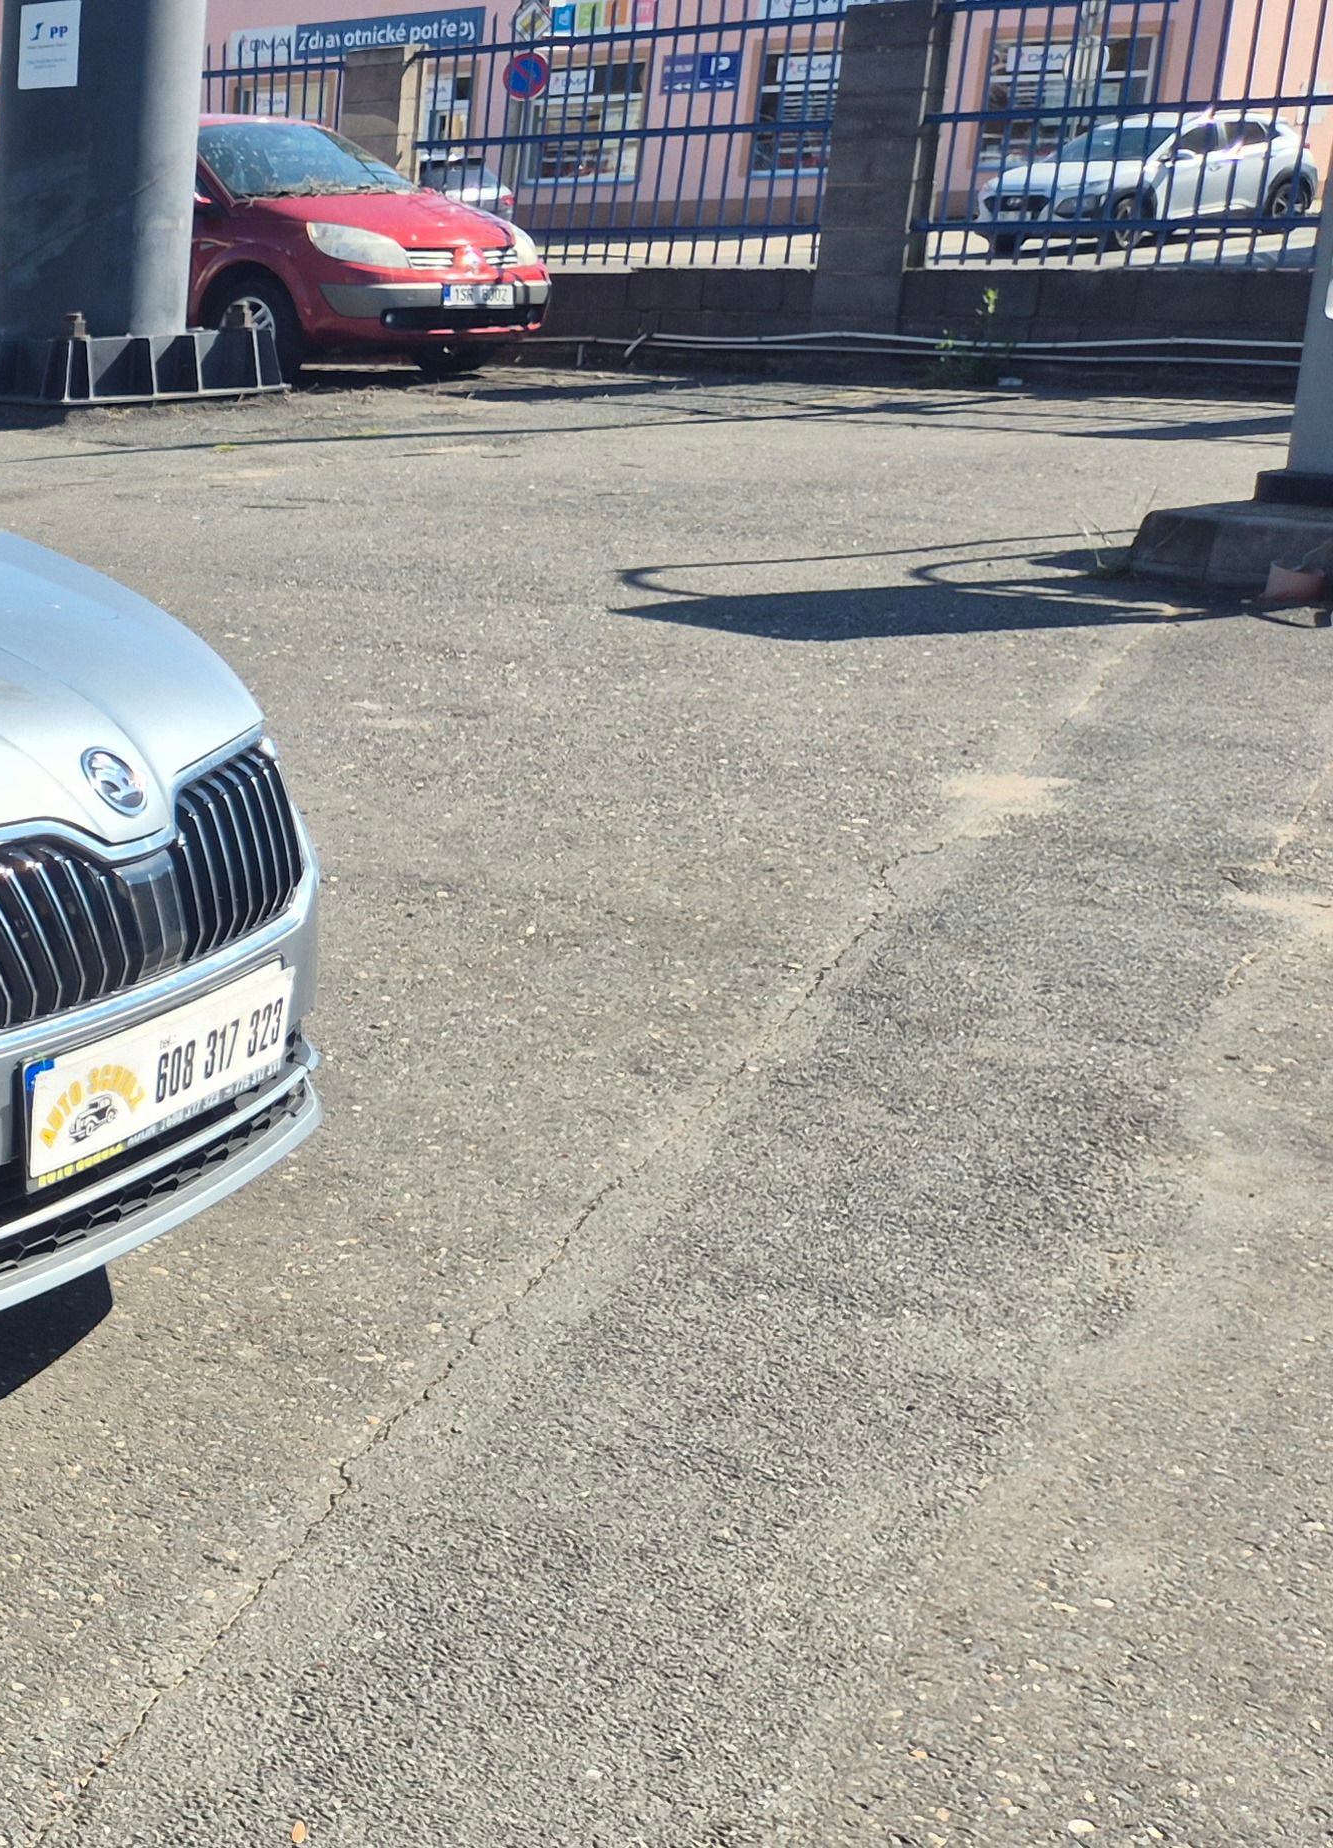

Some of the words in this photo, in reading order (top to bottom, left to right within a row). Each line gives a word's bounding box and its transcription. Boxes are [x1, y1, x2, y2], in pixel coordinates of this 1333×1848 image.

[155, 1039, 196, 1103] 608
[203, 1017, 240, 1080] 317
[246, 996, 284, 1058] 323
[39, 1080, 82, 1149] AUTO
